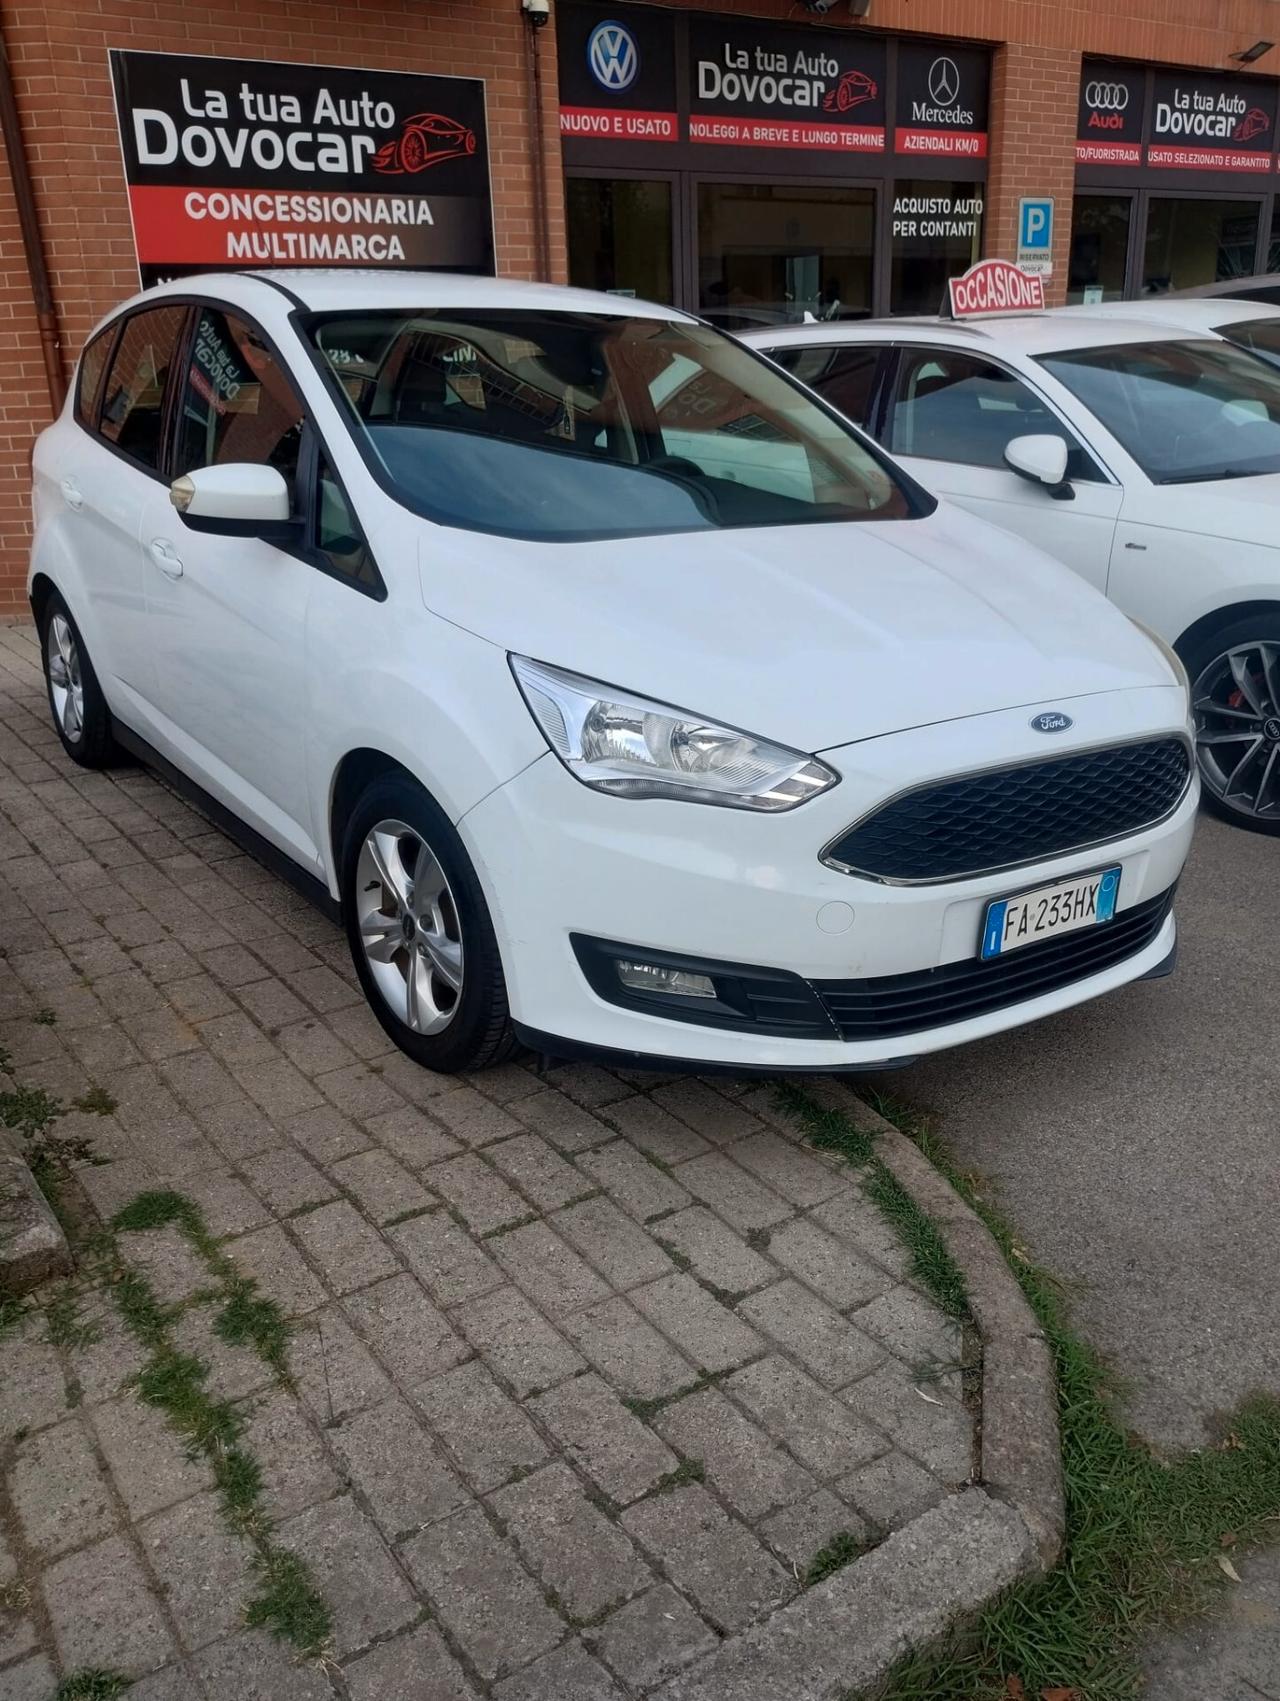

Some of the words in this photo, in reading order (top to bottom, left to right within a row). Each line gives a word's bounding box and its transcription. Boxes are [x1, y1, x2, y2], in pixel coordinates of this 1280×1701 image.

[725, 42, 749, 70] La
[755, 46, 787, 74] tua
[793, 50, 839, 77] Auto
[698, 61, 825, 107] Dovocar
[180, 79, 227, 119] La
[239, 83, 301, 124] tua
[313, 89, 396, 129] Auto
[912, 102, 974, 125] Mercedes
[1174, 88, 1189, 109] La
[1193, 90, 1213, 111] tua
[1216, 93, 1247, 114] Auto
[560, 114, 609, 132] NUOVO
[614, 117, 623, 133] E
[627, 118, 671, 136] USATO
[1088, 111, 1124, 129] Audi
[1155, 103, 1236, 138] Dovocar
[132, 108, 376, 174] Dovocar
[689, 122, 739, 140] NOLEGGI
[742, 126, 750, 140] A
[753, 128, 789, 142] BREVE
[792, 129, 799, 143] E
[802, 129, 838, 145] LUNGO
[840, 132, 885, 147] TERMINE
[904, 136, 953, 151] AZIENDALI
[955, 138, 979, 154] KM/0
[1148, 151, 1172, 163] USATO
[1174, 153, 1223, 166] SELEZIONATO
[1225, 155, 1230, 166] E
[1232, 155, 1271, 169] GARANTITO
[184, 192, 434, 226] CONCESSIONARIA
[893, 197, 950, 216] ACQUISTO
[953, 199, 983, 215] AUTO
[893, 221, 916, 237] PER
[920, 221, 977, 237] CONTANTI
[1027, 208, 1046, 244] P
[226, 232, 405, 261] MULTIMARCA
[955, 266, 1042, 310] OCCASIONE
[1040, 715, 1066, 730] Ford
